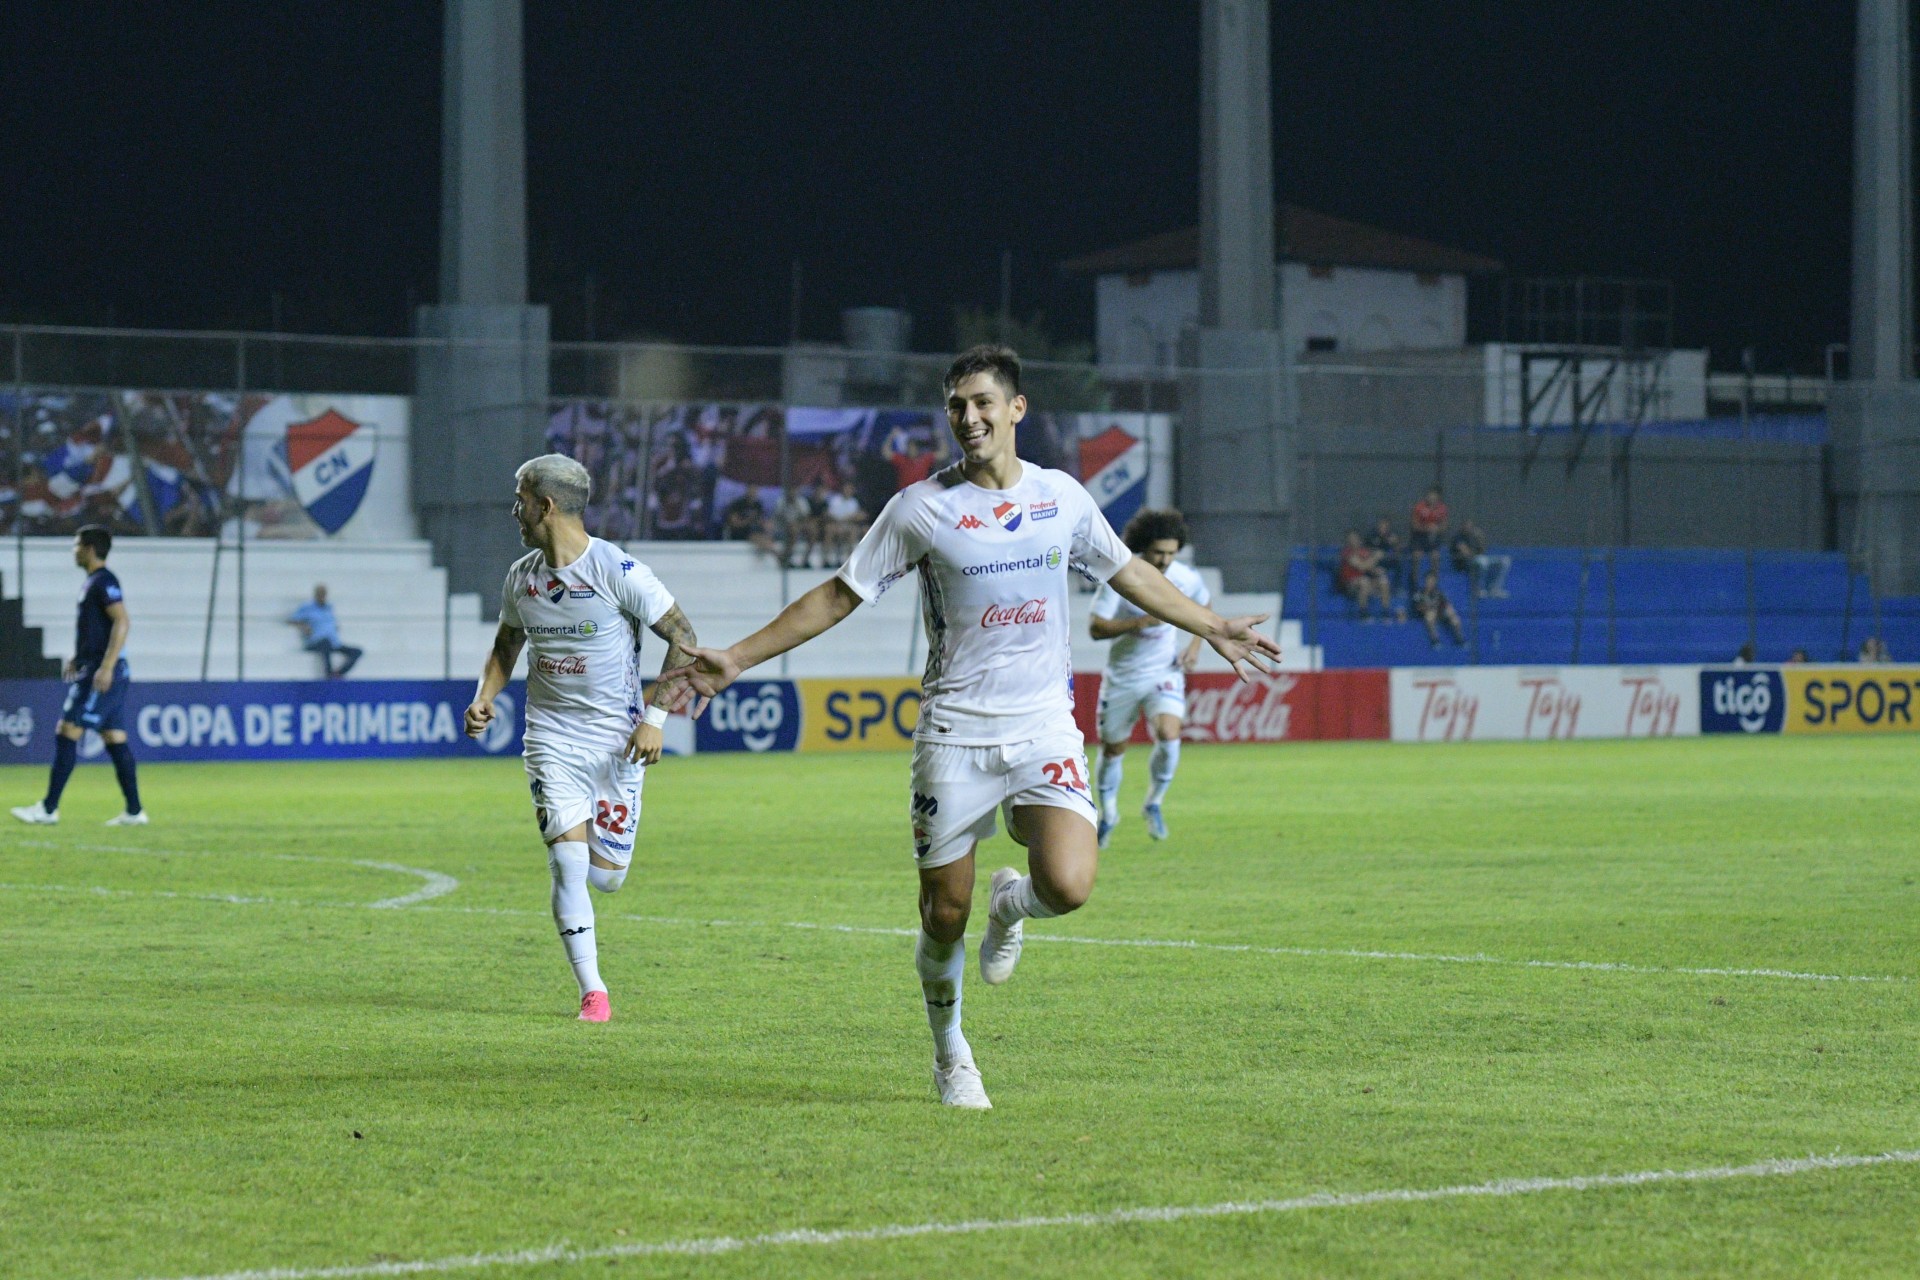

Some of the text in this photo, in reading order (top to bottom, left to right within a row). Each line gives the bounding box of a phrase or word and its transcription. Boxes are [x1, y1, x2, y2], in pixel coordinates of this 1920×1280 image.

[1004, 511, 1015, 521] CN
[1031, 509, 1057, 520] MAXIVIT
[962, 554, 1043, 576] continental
[981, 597, 1048, 628] Coca-Cola
[537, 655, 588, 675] Coca-Cola
[825, 690, 921, 741] SPO
[1412, 679, 1479, 740] Tajy
[1519, 677, 1580, 739] Tajy
[1621, 675, 1680, 738] Tajy
[137, 701, 458, 747] COPA DE PRIMERA
[1042, 758, 1087, 791] 21
[595, 800, 628, 835] 22
